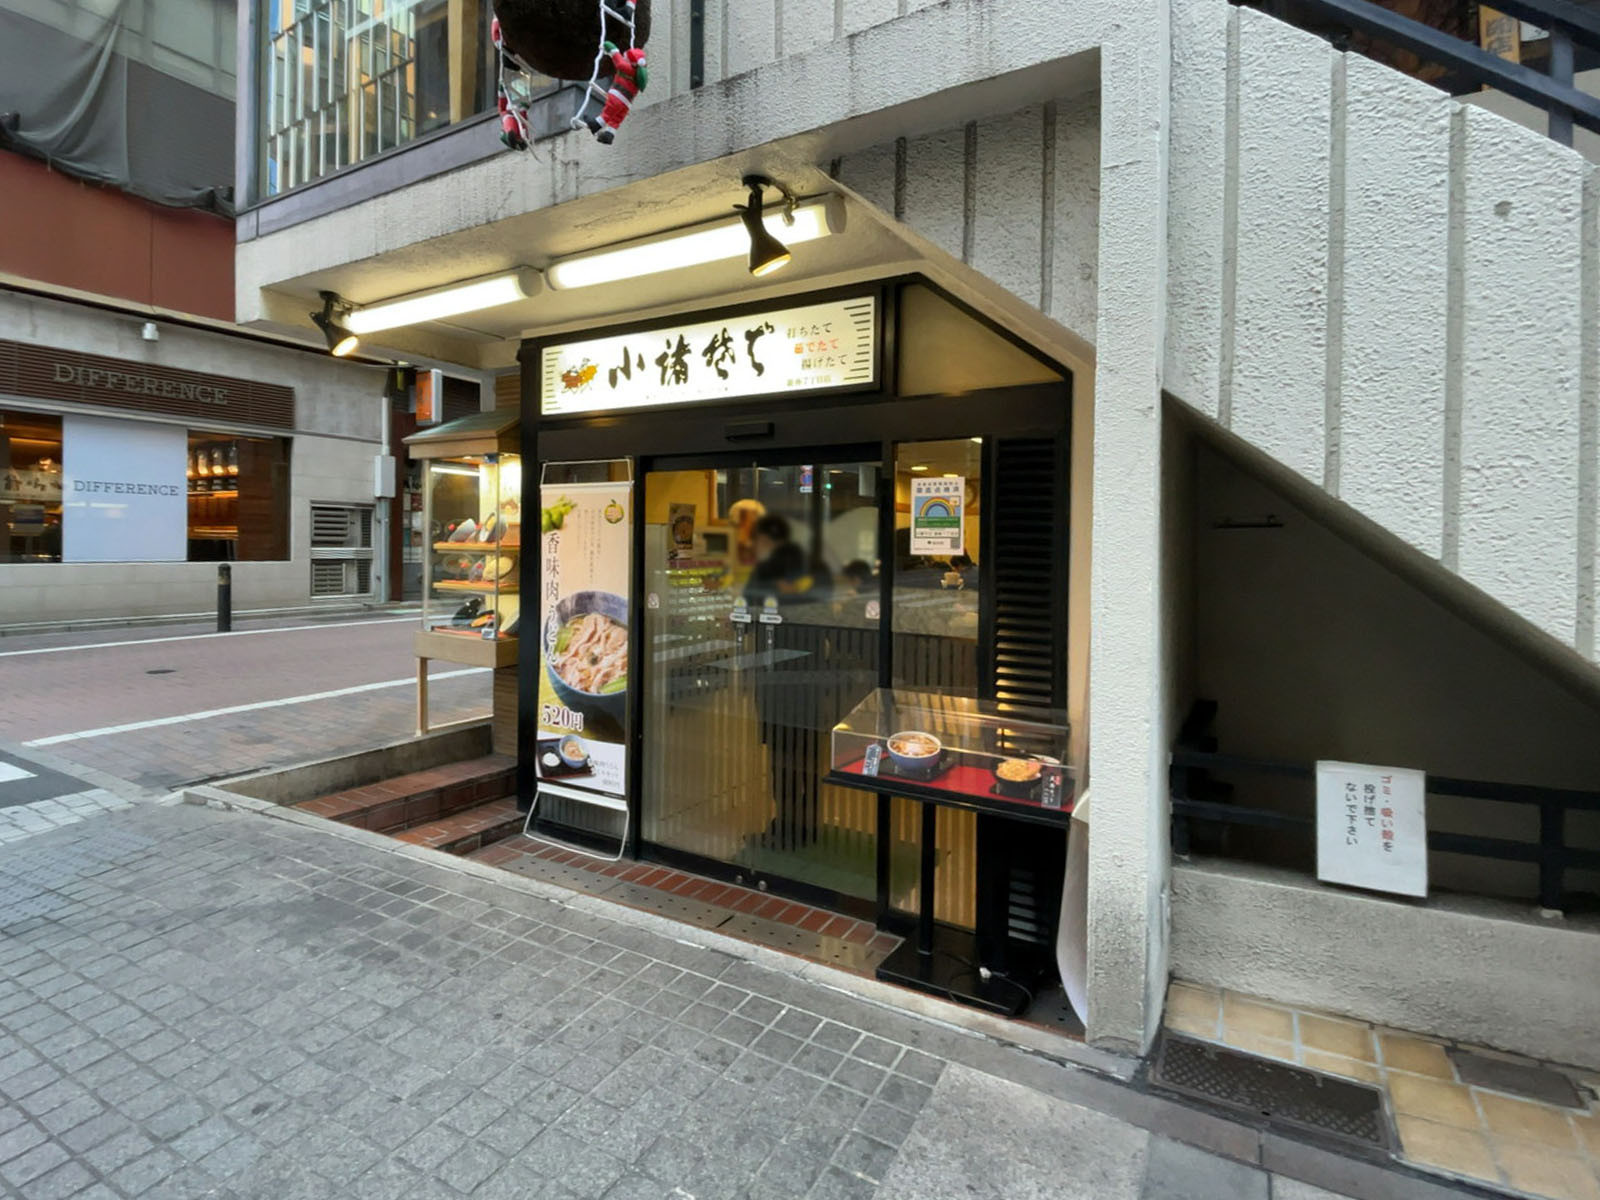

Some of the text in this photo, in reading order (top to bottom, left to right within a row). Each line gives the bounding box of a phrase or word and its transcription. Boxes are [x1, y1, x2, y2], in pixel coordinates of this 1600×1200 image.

[53, 364, 229, 405] DIFFERENCE
[73, 480, 180, 497] DIFFERENCE
[543, 705, 583, 730] 520円
[1345, 782, 1358, 846] ないで下さい
